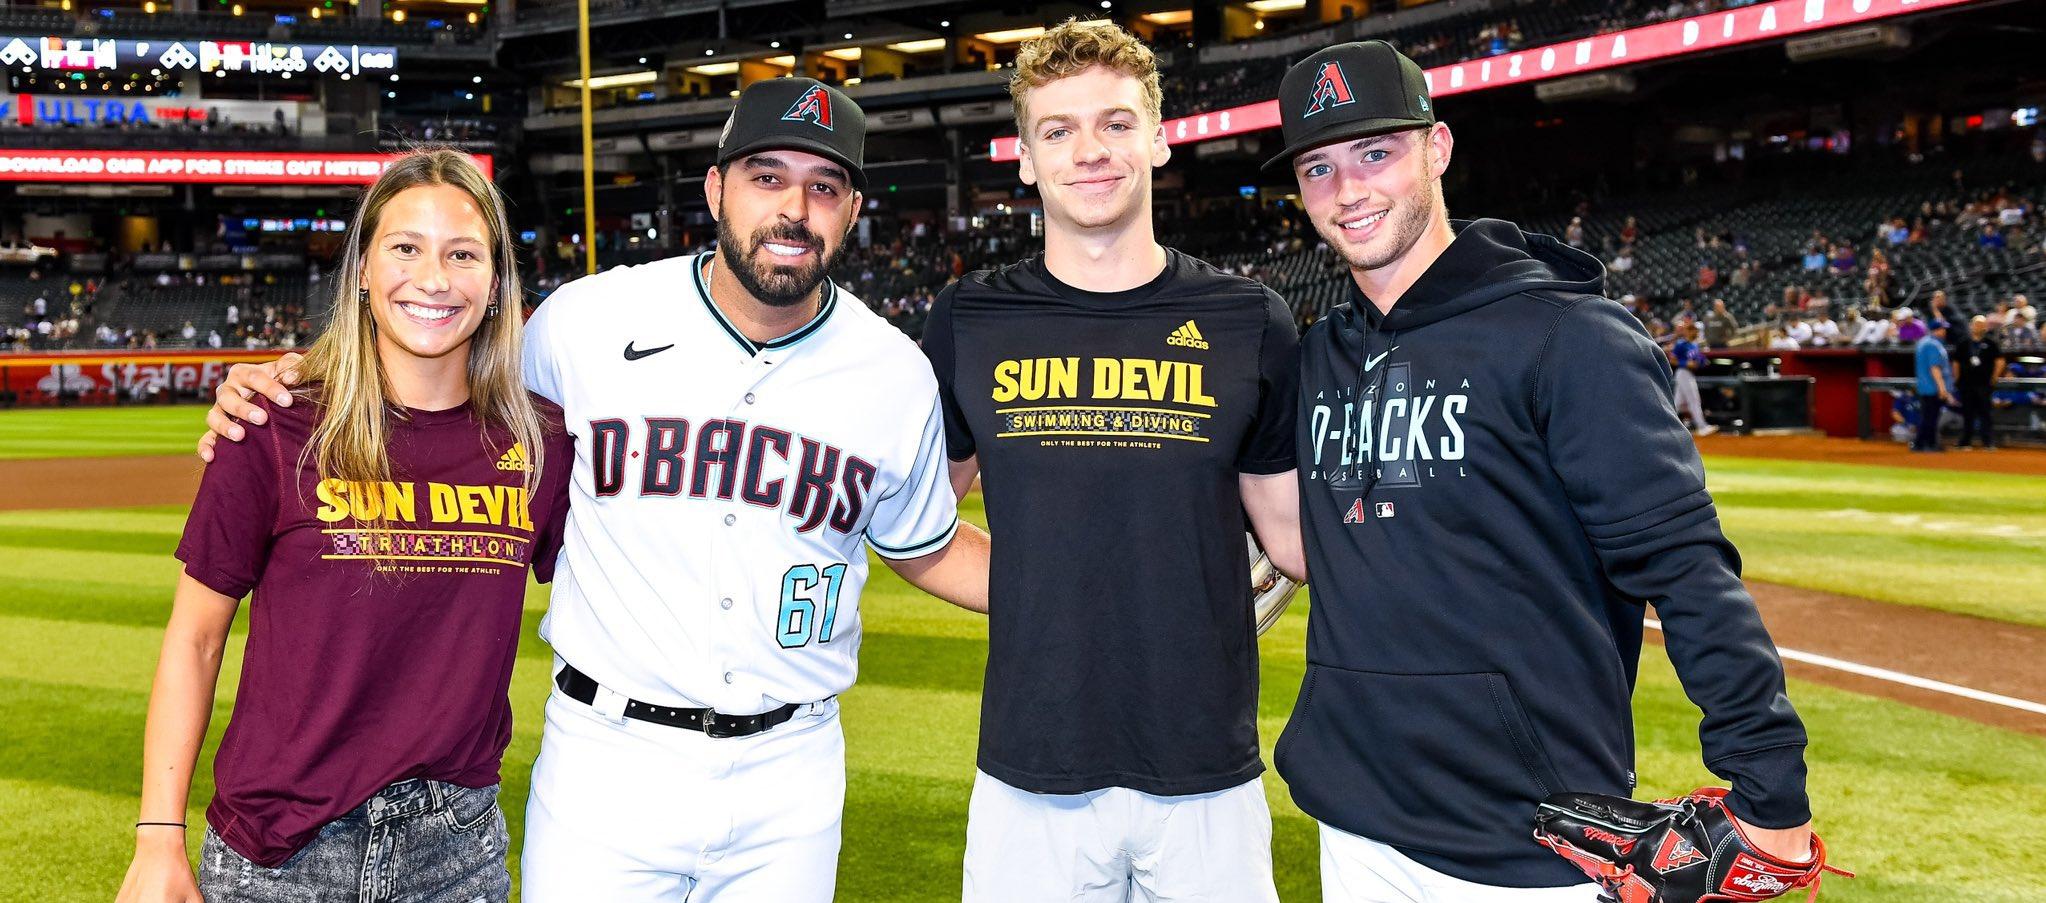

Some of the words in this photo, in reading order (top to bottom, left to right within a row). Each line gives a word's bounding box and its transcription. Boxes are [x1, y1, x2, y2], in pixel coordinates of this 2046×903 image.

[38, 99, 149, 124] ULTRA
[105, 157, 146, 174] OUR
[147, 158, 184, 174] APP
[1166, 335, 1210, 350] adidas
[992, 357, 1081, 403] SUN
[1091, 358, 1219, 408] DEVIL
[1013, 414, 1105, 430] SWIMMING
[1113, 415, 1124, 429] &
[1131, 416, 1195, 433] DIVING
[1096, 440, 1112, 448] FOR
[1114, 440, 1128, 448] THE
[1129, 441, 1162, 449] ATHLETE
[316, 477, 416, 523] SUN
[428, 481, 535, 532] DEVIL
[359, 536, 514, 557] TRIATHLON
[470, 567, 501, 575] ATHLETE
[775, 563, 848, 649] 61
[1732, 873, 1793, 893] Rawlings
